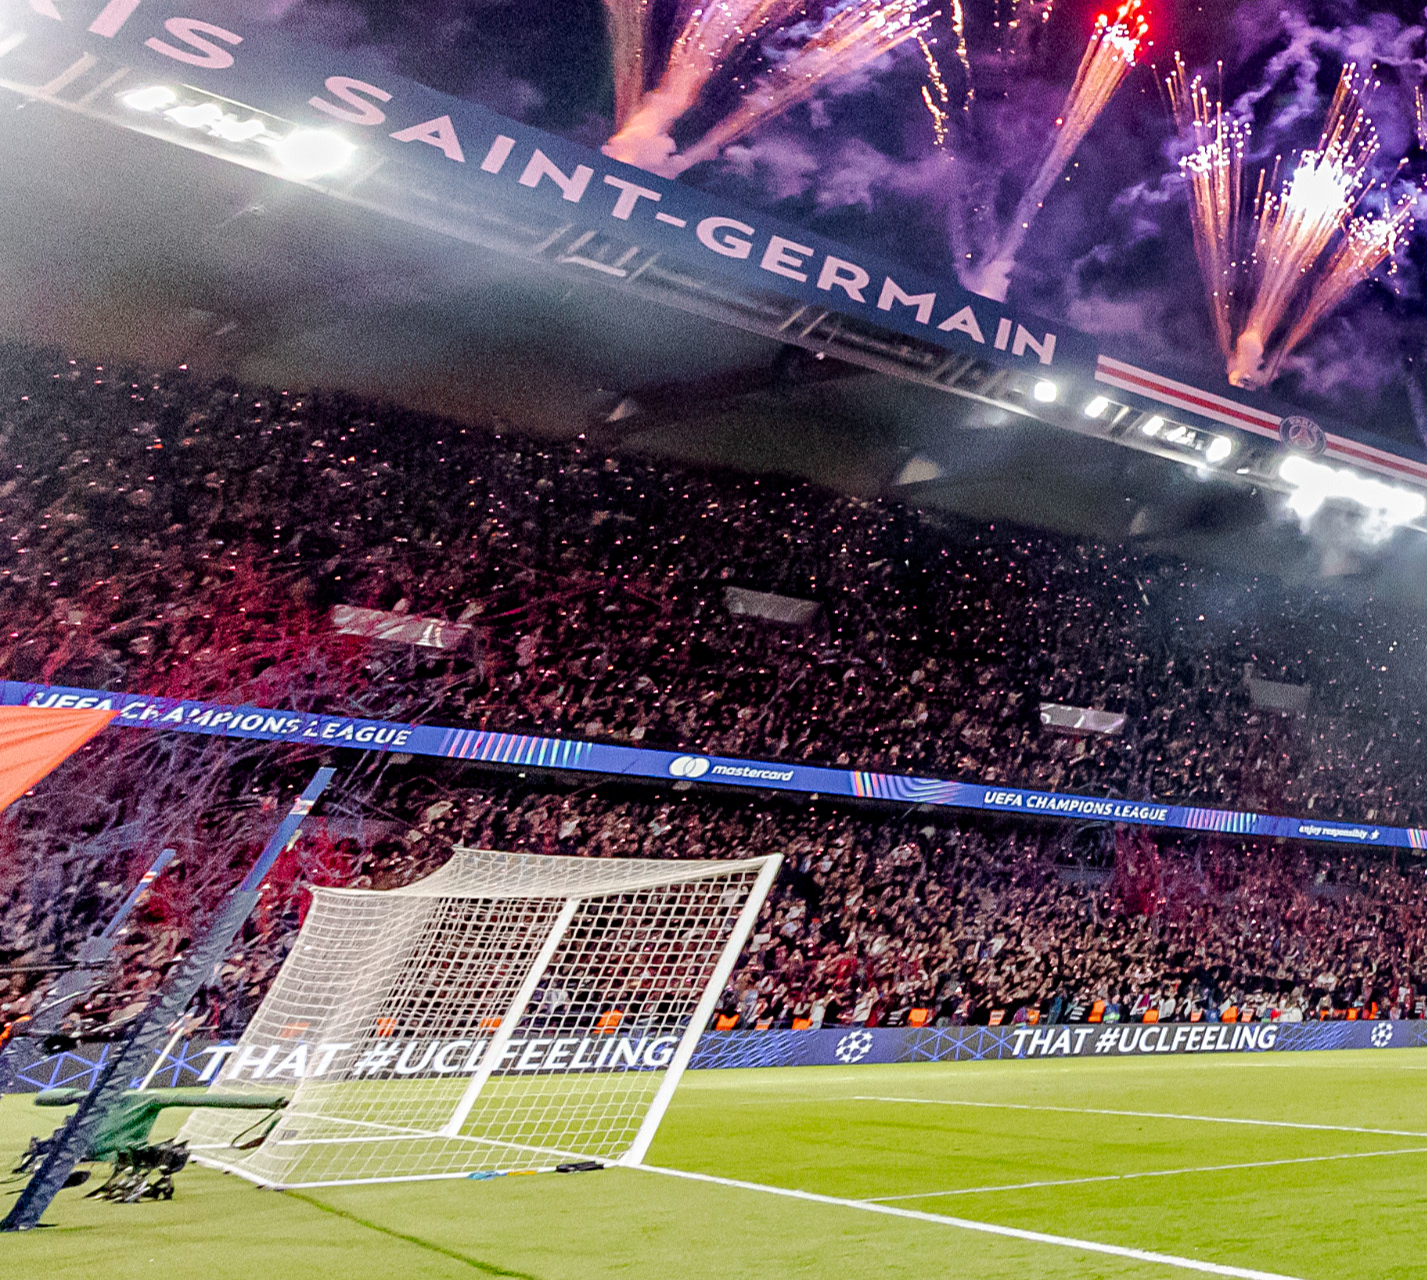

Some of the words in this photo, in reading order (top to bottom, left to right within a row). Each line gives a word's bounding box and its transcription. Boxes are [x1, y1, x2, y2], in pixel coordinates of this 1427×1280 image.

[308, 75, 1058, 366] SAINT-GERMAIN
[119, 701, 302, 734] CHAMPIONS
[302, 721, 412, 746] LEAGUE
[711, 764, 794, 782] mastercard
[984, 791, 1022, 807] UEFA
[1026, 795, 1114, 815] CHAMPIONS
[1114, 806, 1167, 821] LEAGUE
[196, 1042, 353, 1082] THAT
[352, 1034, 680, 1077] #UCLFEELING
[1012, 1028, 1094, 1056] THAT
[1095, 1024, 1279, 1055] #UCLFEELING
